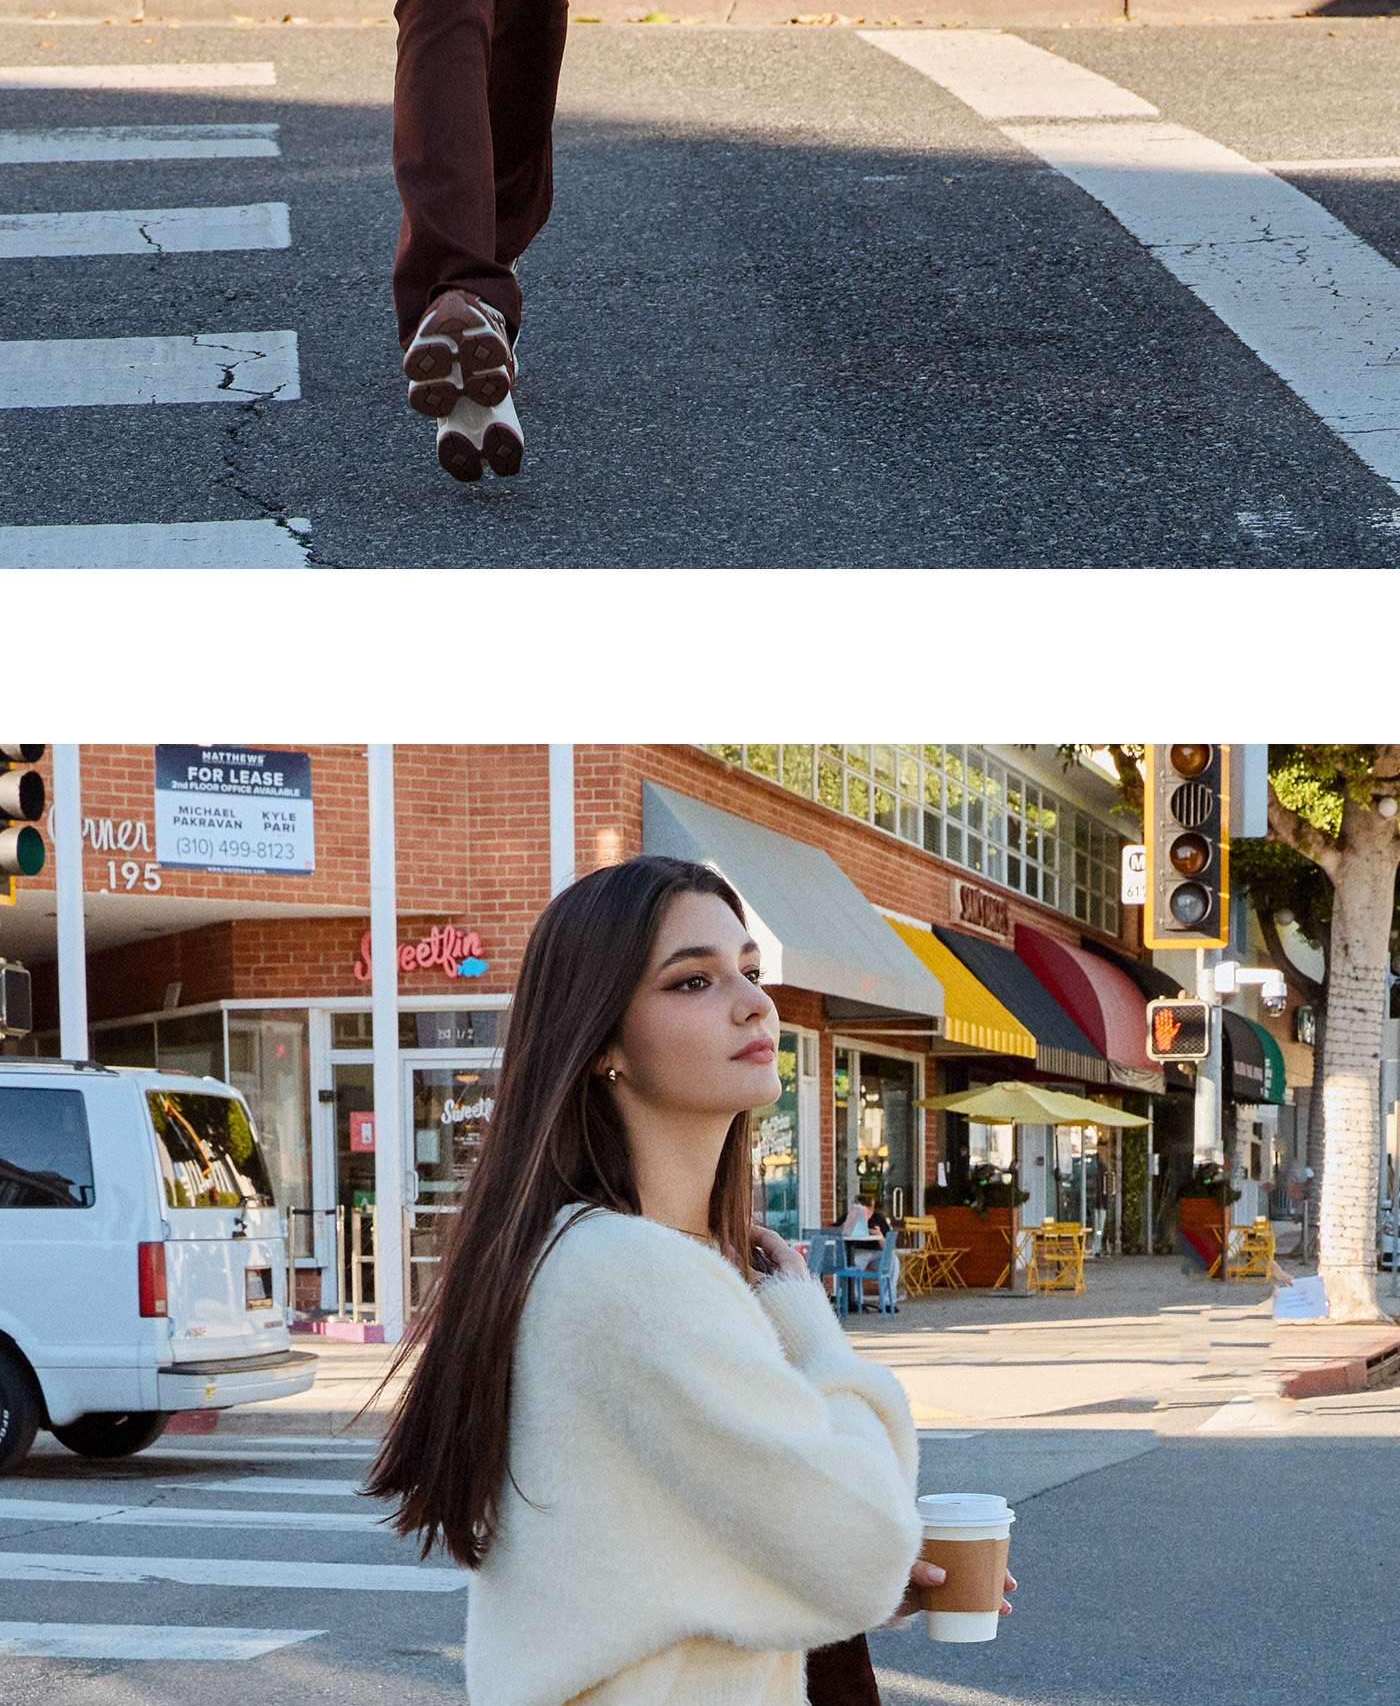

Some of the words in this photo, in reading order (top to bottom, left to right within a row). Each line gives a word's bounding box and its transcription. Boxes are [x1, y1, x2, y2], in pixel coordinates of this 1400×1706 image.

[187, 766, 224, 782] FOR
[229, 769, 284, 786] LEASE
[171, 780, 188, 790] 2nd
[189, 782, 220, 792] FLOOR
[220, 783, 252, 794] OFFICE
[253, 786, 300, 797] AVAILABLE
[178, 805, 236, 818] MICHAEL
[262, 811, 296, 822] KYLE
[173, 816, 243, 829] PAKRAVAN
[263, 822, 296, 833] PARI
[176, 837, 214, 859] (310)
[218, 839, 295, 860] 499-8123
[107, 860, 162, 892] 195
[353, 925, 483, 982] Seetfin
